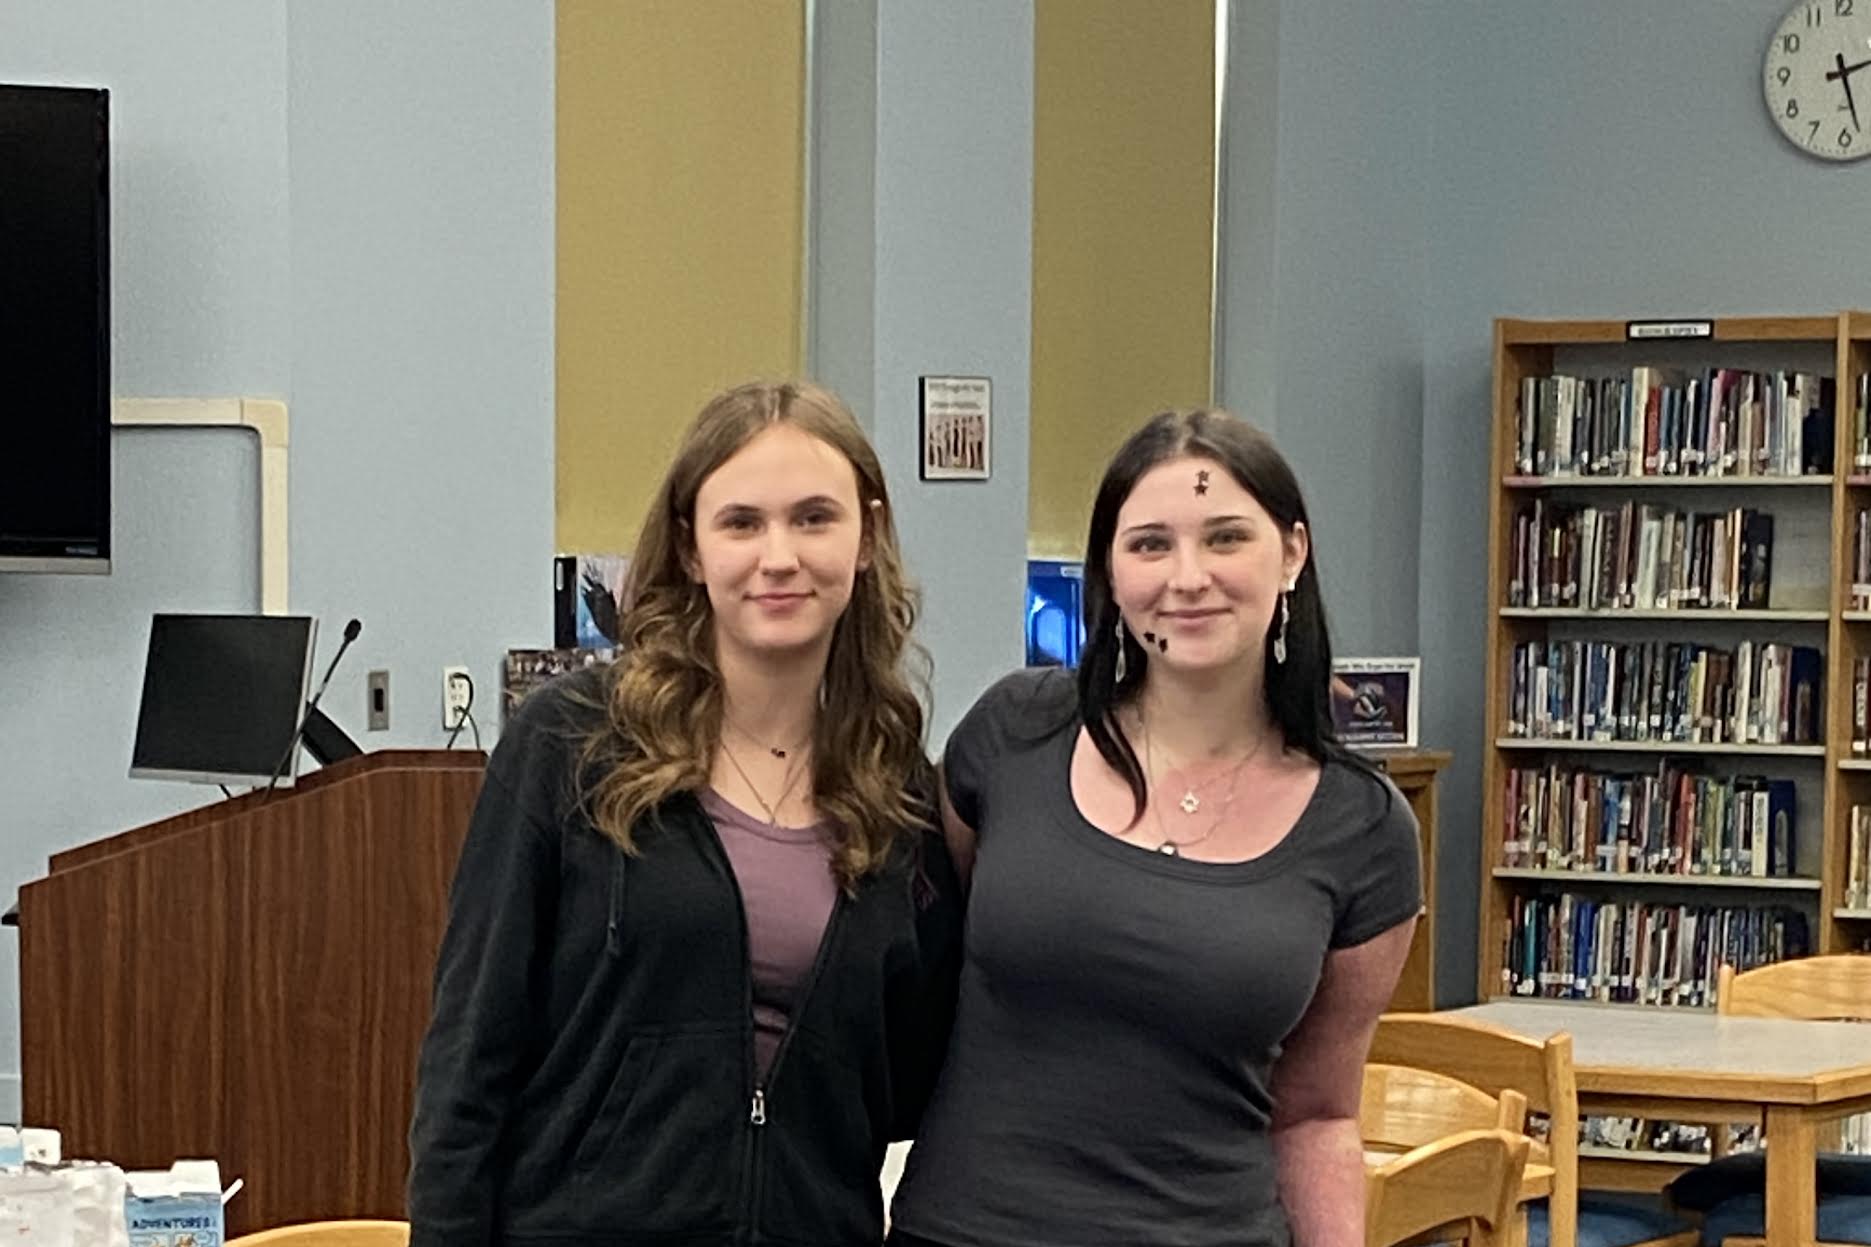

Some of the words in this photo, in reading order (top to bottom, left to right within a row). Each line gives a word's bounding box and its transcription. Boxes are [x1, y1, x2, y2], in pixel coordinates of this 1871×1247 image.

[1806, 6, 1821, 27] 11
[1835, 0, 1853, 16] 12
[1783, 33, 1800, 53] 10
[1777, 66, 1791, 87] 9
[1786, 98, 1799, 118] 8
[1808, 120, 1820, 144] 7
[1838, 128, 1852, 148] 6
